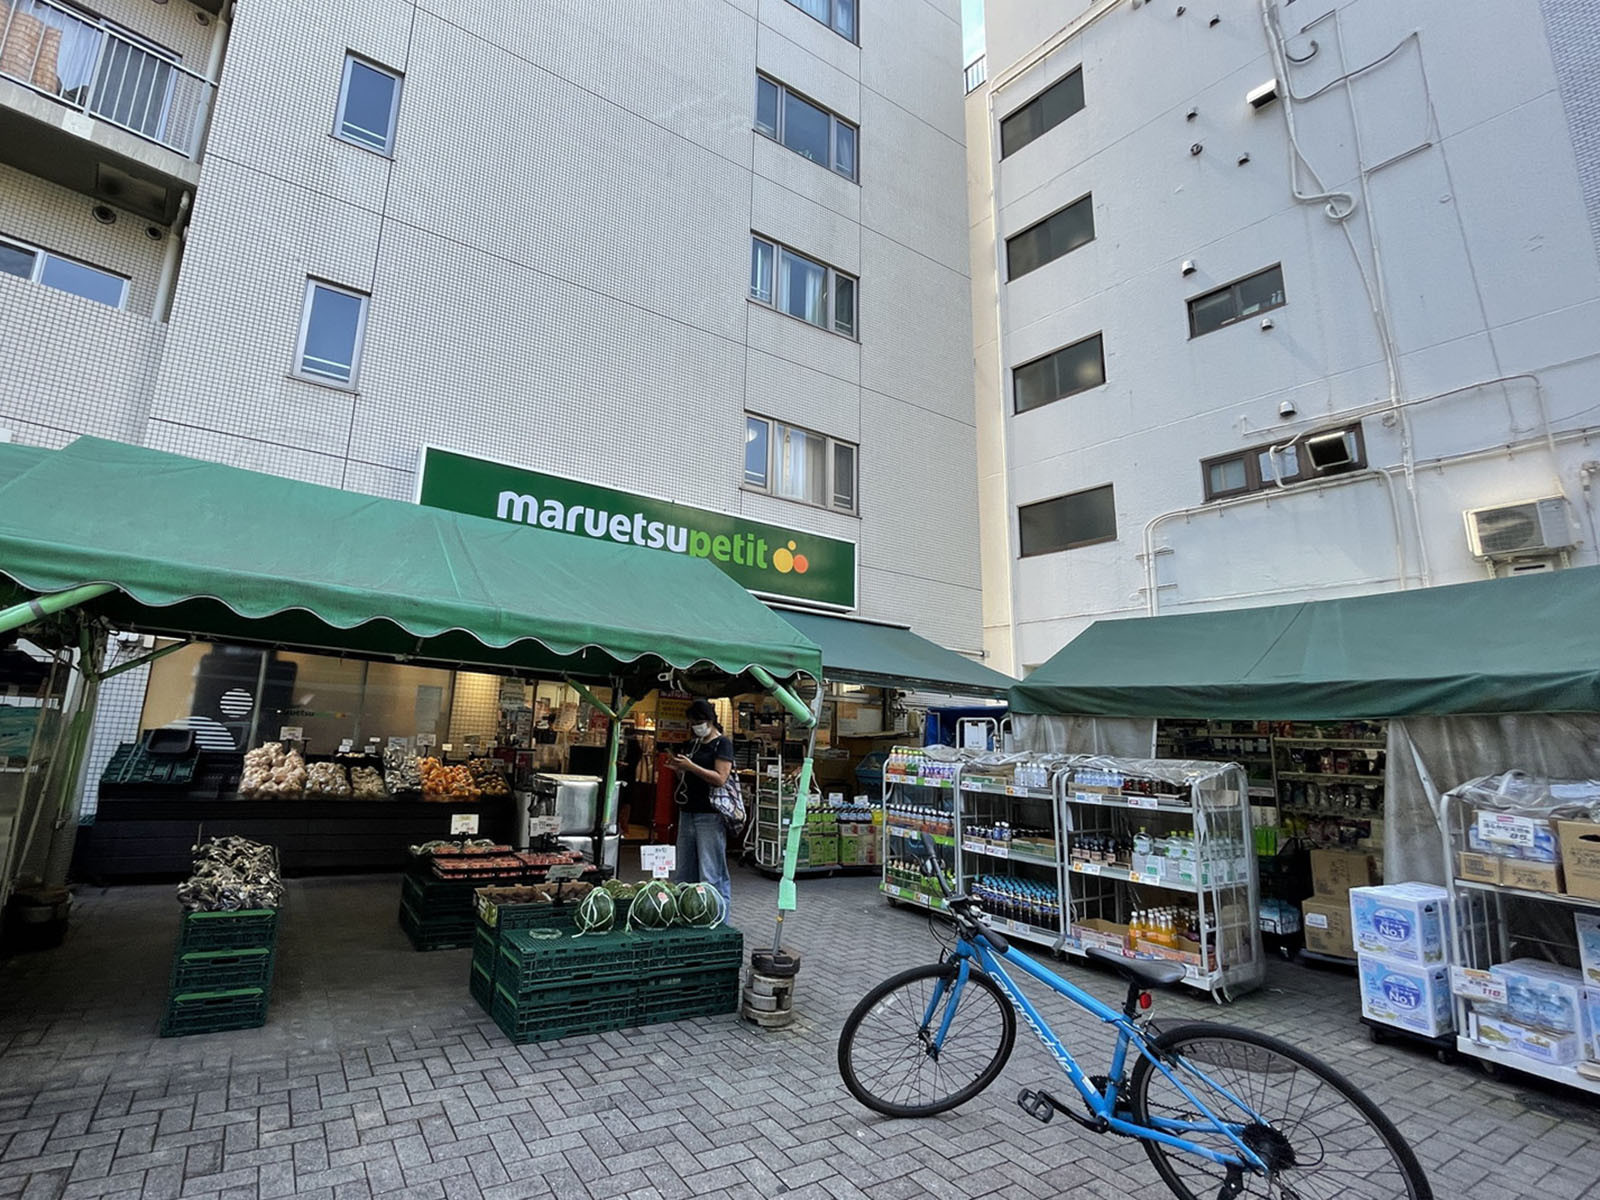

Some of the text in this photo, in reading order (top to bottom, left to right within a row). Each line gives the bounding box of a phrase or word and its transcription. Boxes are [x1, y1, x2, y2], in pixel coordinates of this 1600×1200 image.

[1379, 924, 1405, 939] No.1
[1389, 991, 1416, 1006] No.1
[988, 971, 1073, 1073] cannondale
